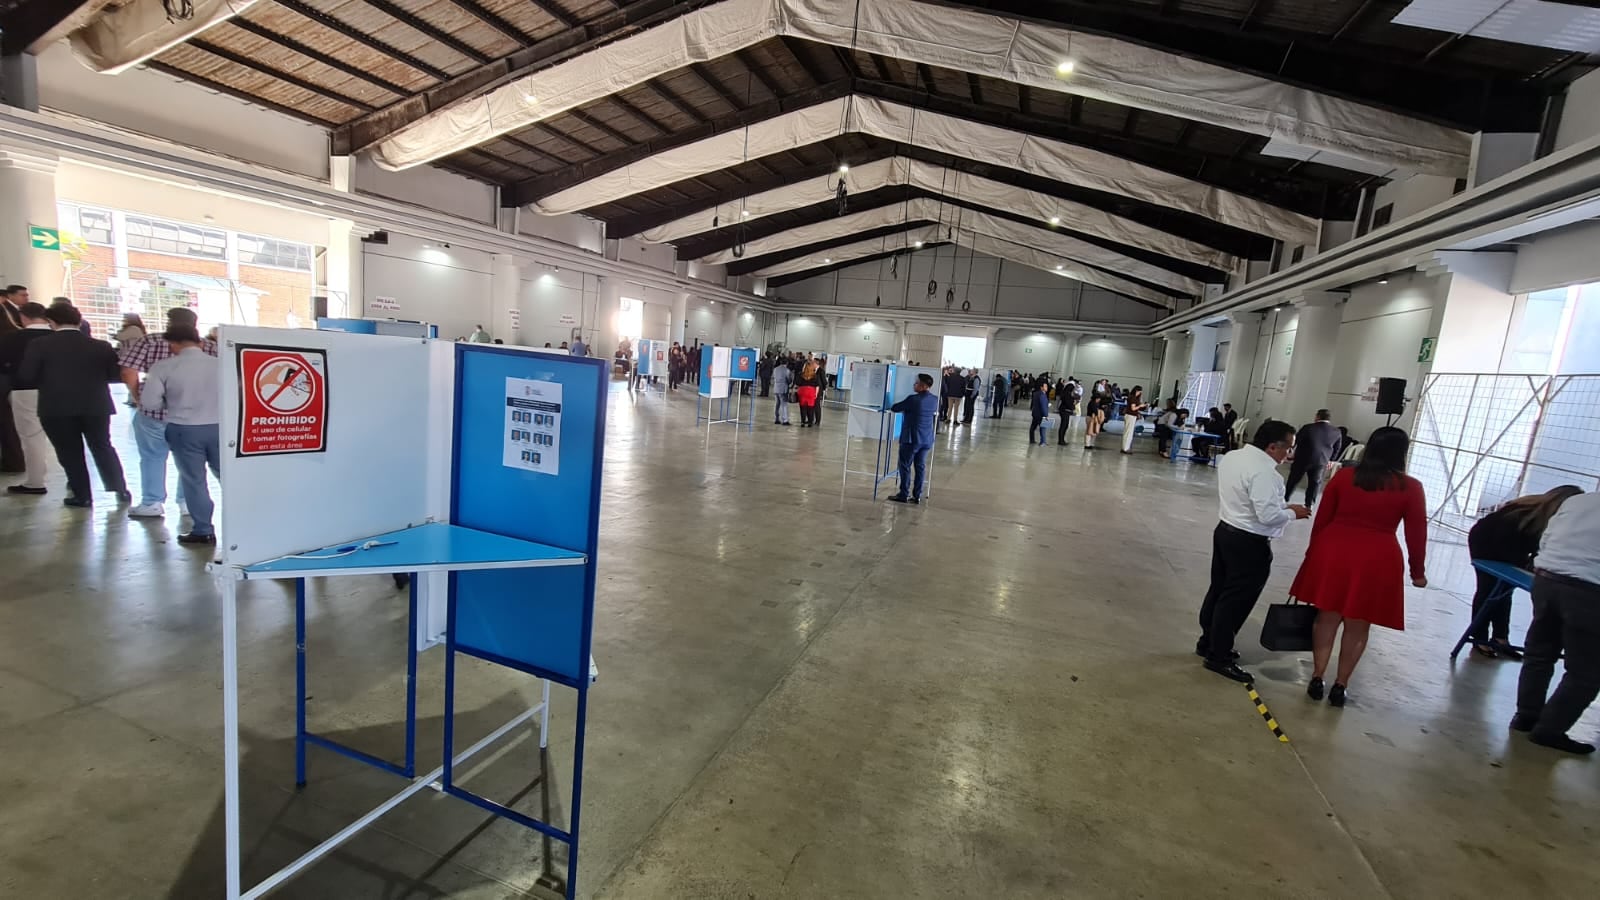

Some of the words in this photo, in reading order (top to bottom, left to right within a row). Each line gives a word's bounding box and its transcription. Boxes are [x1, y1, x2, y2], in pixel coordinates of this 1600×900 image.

[251, 416, 316, 425] PROHIBIDO
[286, 425, 311, 433] celular
[270, 442, 286, 450] esta
